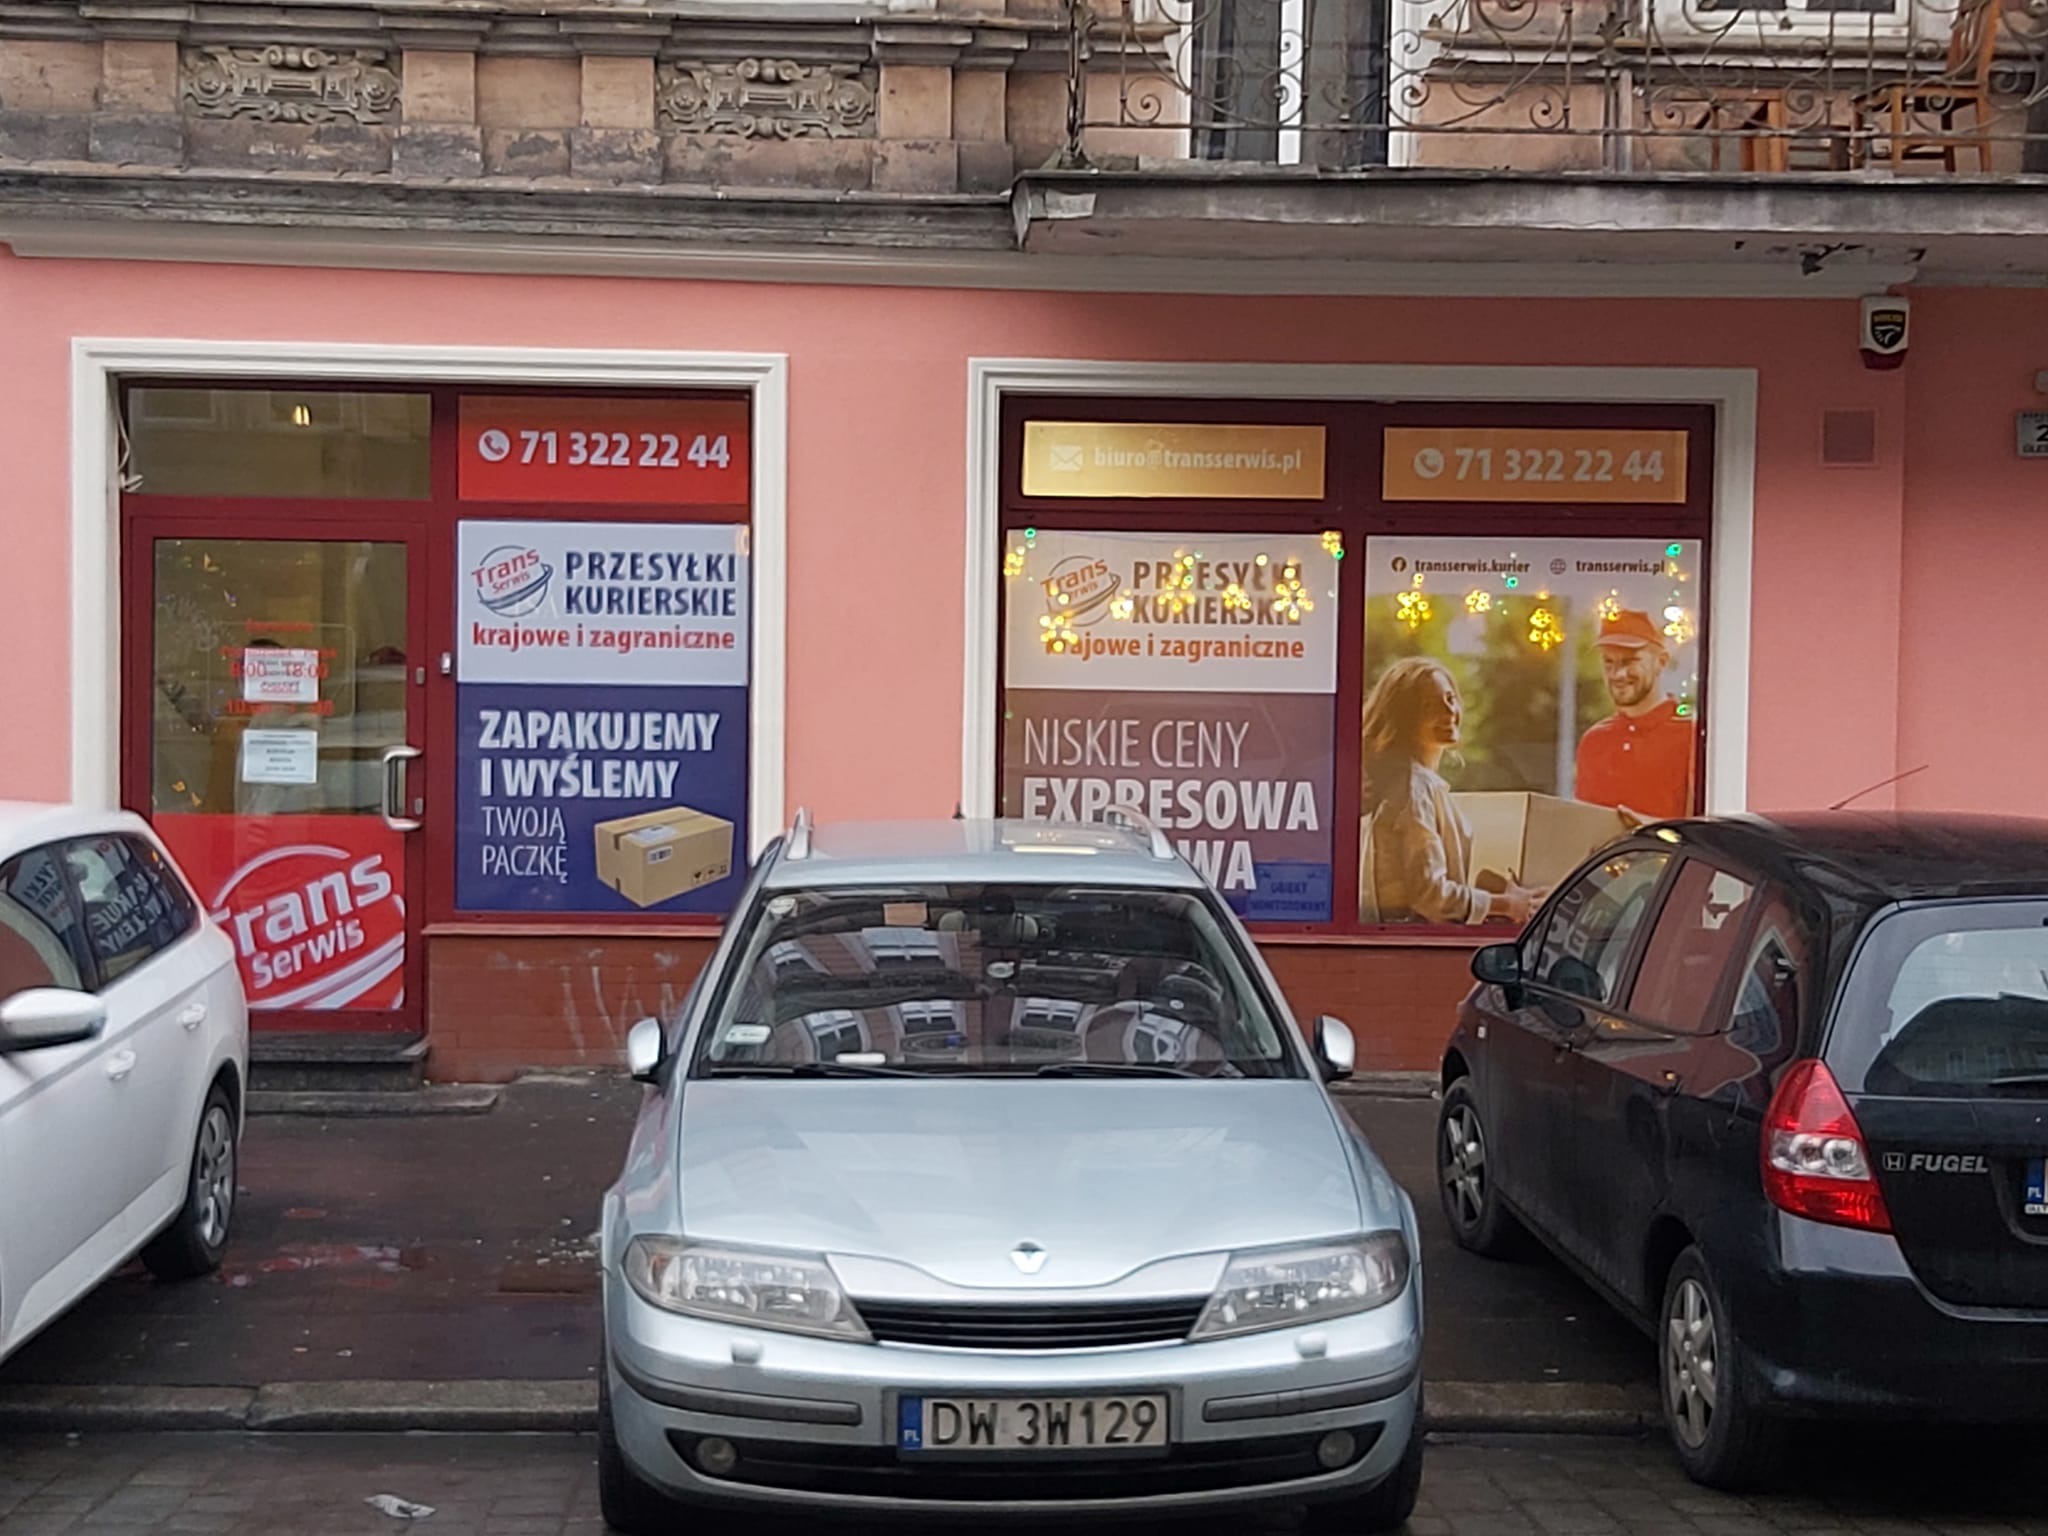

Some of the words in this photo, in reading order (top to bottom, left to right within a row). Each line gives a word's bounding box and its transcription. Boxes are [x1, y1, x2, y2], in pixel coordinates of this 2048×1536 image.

[520, 430, 558, 464] 71
[568, 432, 630, 466] 322
[638, 434, 680, 468] 22
[687, 435, 730, 469] 44
[1095, 447, 1301, 475] biuro@transserwis.pl
[1455, 449, 1491, 480] 71
[1503, 450, 1564, 481] 322
[1573, 450, 1613, 481] 22
[1622, 451, 1664, 482] 44
[472, 549, 540, 588] Trans
[565, 552, 736, 582] PRZESYŁKI
[1040, 559, 1108, 598] Trans
[1415, 559, 1531, 574] transserwis.kurier
[1576, 559, 1665, 575] transserwis.pl
[565, 586, 736, 616] KURIERSKIE
[472, 622, 570, 652] krajowe
[577, 624, 584, 646] i
[590, 625, 735, 654] zagraniczne
[1147, 633, 1154, 656] i
[1160, 634, 1304, 662] zagraniczne
[479, 710, 720, 751] ZAPAKUJEMY
[1024, 718, 1140, 767] NISKIE
[1152, 720, 1249, 768] CENY
[481, 759, 492, 797] I
[501, 753, 679, 798] WYŚLEMY
[1023, 777, 1319, 831] EXPRESOWA
[481, 806, 566, 844] TWOJĄ
[482, 846, 567, 884] PACZKĘ
[252, 919, 365, 989] Serwis
[1909, 1154, 1989, 1174] FUGEL
[2027, 1186, 2042, 1199] PL
[903, 1429, 921, 1442] PL
[931, 1401, 998, 1446] DW
[1016, 1400, 1158, 1446] 3W129
